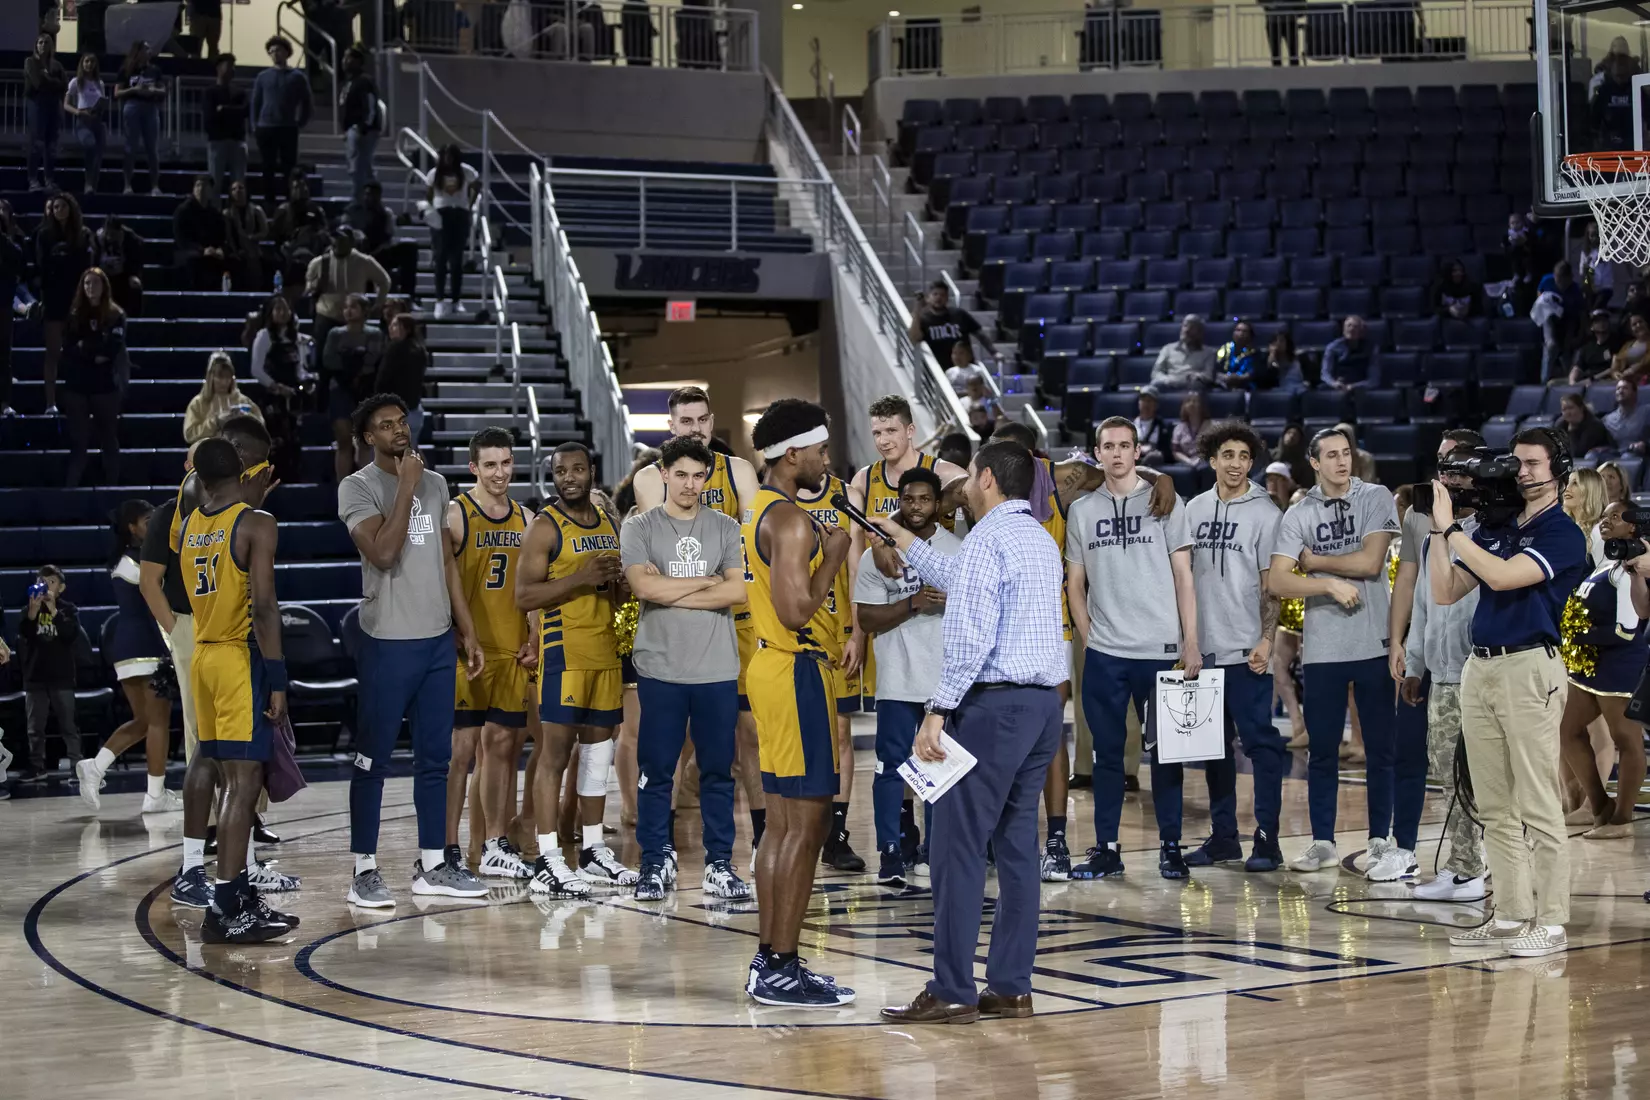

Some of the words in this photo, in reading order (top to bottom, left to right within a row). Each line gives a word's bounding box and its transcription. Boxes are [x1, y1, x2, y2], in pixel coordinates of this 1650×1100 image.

[1553, 190, 1580, 201] SPALDING
[1095, 516, 1142, 538] CBU
[1196, 521, 1239, 540] CBU
[476, 531, 522, 548] LANCERS
[572, 534, 619, 554] LANCERS
[1088, 536, 1154, 550] BASKETBALL
[1193, 541, 1244, 553] ASKETBALL
[194, 552, 220, 597] 31
[486, 553, 508, 590] 3
[906, 773, 927, 796] TIPOFF
